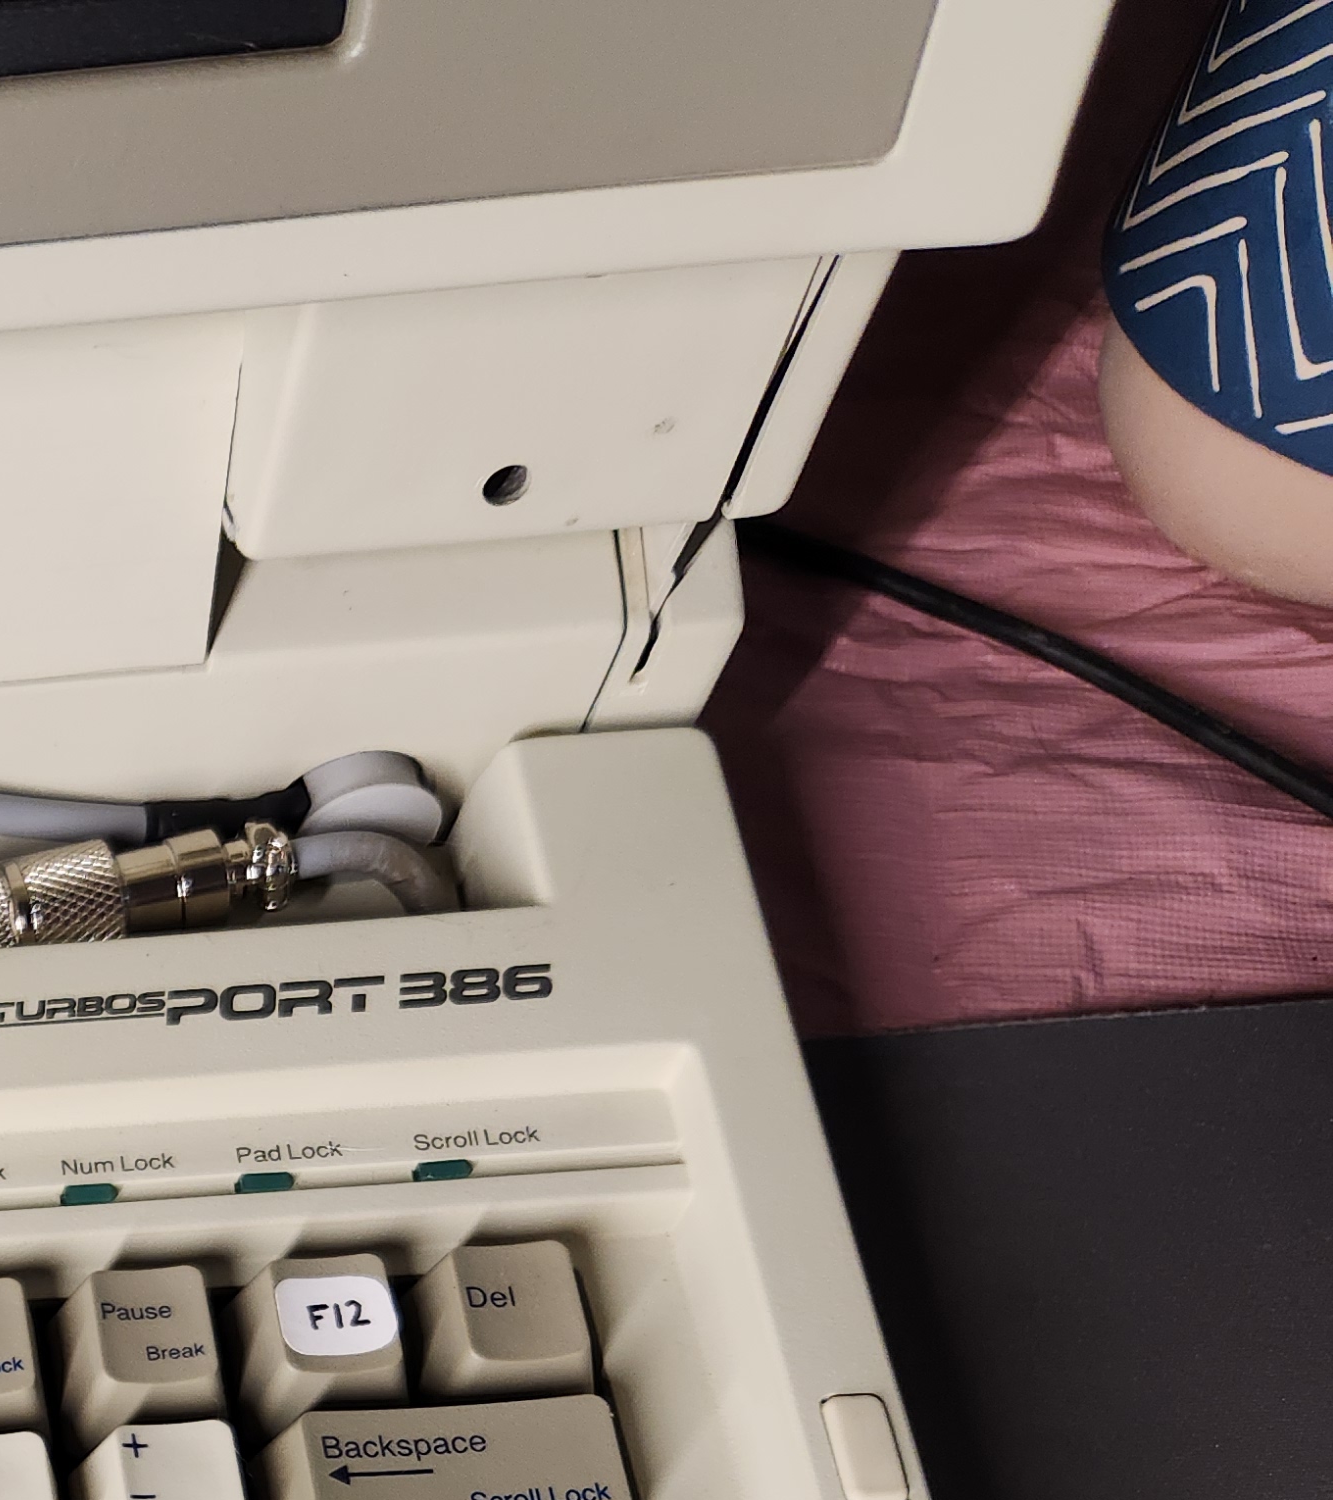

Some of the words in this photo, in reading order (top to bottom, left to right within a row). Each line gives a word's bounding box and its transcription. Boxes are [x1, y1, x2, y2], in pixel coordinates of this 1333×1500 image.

[399, 963, 552, 1009] 386
[414, 1131, 479, 1151] Scroll
[486, 1126, 540, 1146] Lock
[237, 1144, 281, 1163] Pad
[289, 1141, 343, 1160] Lock
[62, 1157, 114, 1176] Num
[121, 1153, 174, 1172] Lock
[466, 1286, 515, 1309] Del
[101, 1301, 172, 1321] Pause
[307, 1299, 372, 1330] F12
[146, 1342, 205, 1361] Break
[321, 1432, 487, 1459] Backspace
